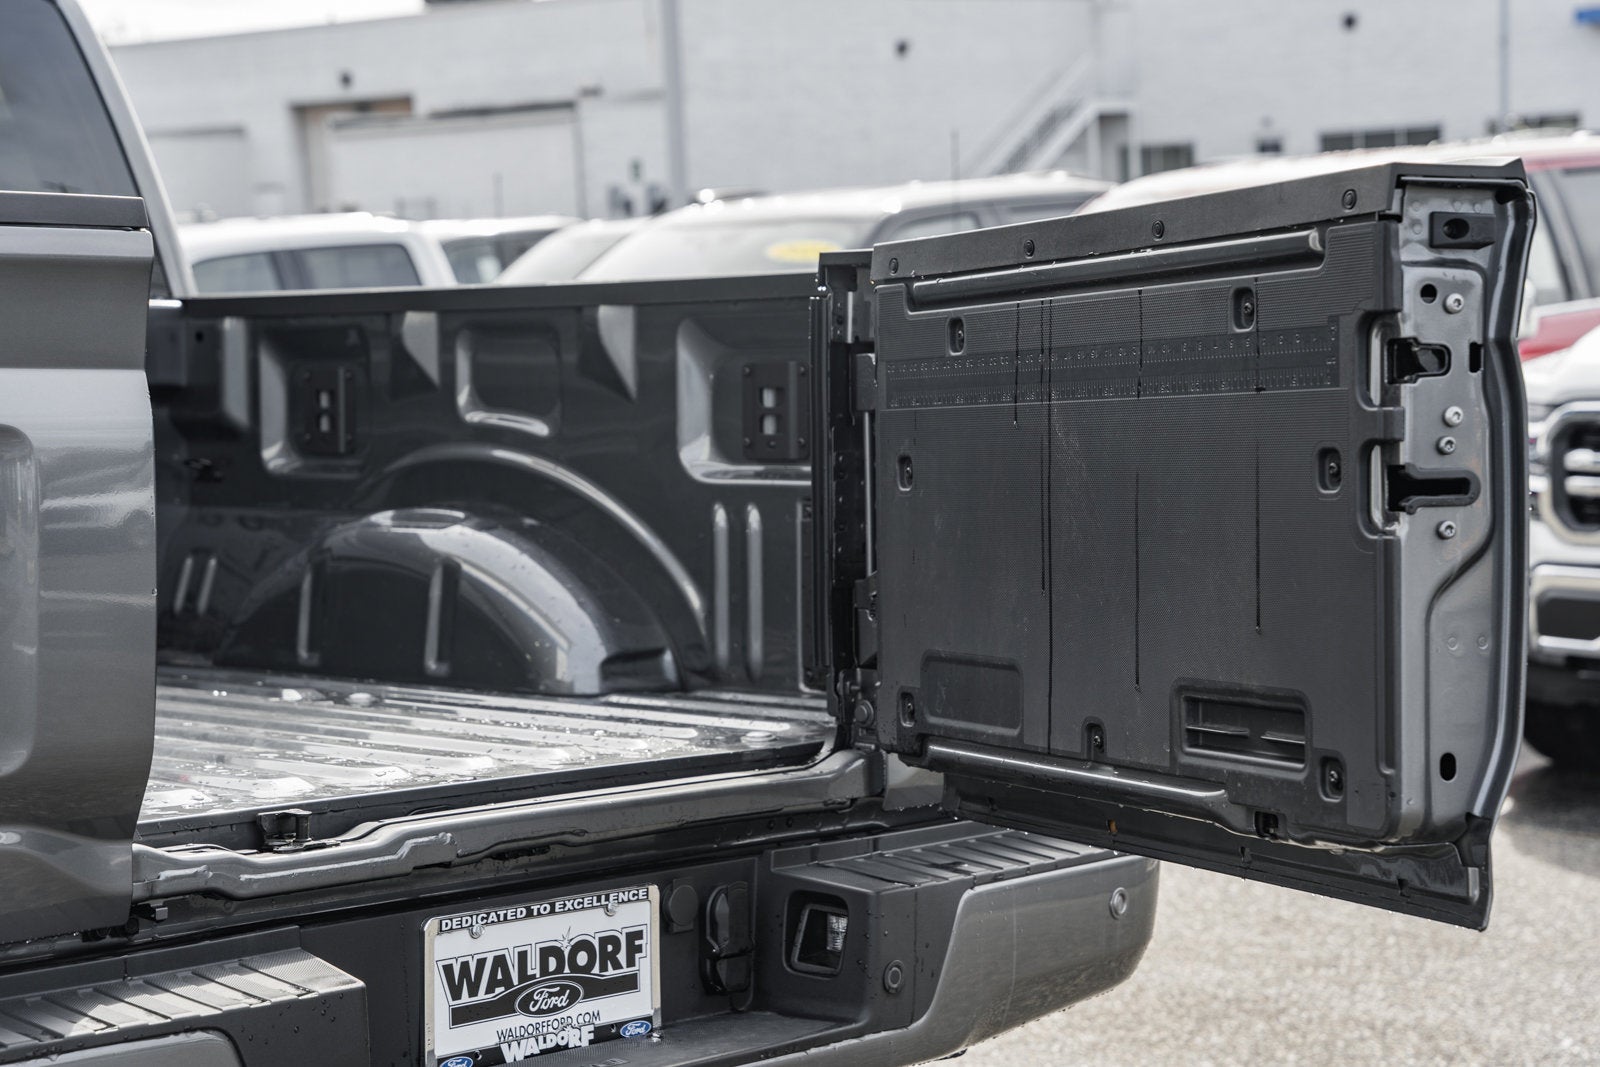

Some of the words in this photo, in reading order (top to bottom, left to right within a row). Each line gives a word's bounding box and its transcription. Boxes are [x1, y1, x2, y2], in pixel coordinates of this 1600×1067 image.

[441, 907, 527, 931] DEDICATED
[533, 904, 550, 916] TO
[554, 888, 648, 912] EXCELLENCE
[442, 929, 644, 1002] WALDORF
[529, 986, 569, 1012] Ford
[496, 1010, 601, 1042] WALDORFFORD.COM
[500, 1023, 595, 1063] WALDORF
[625, 1022, 646, 1036] Ford
